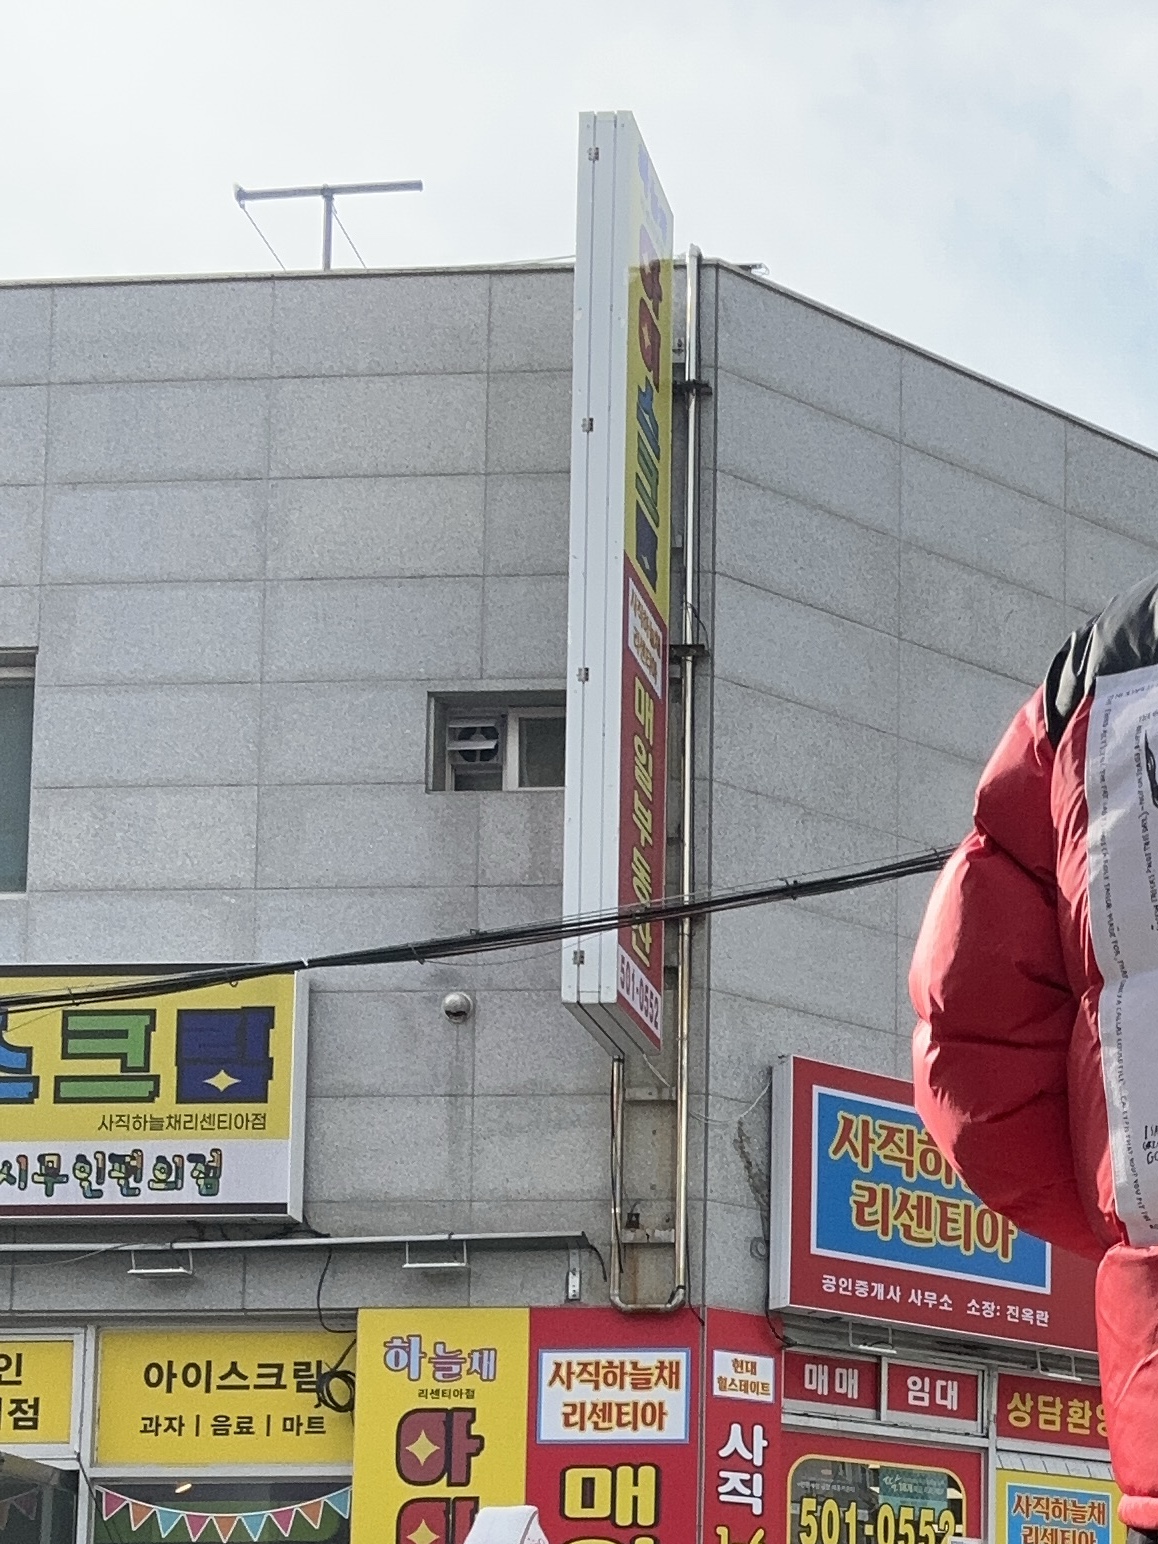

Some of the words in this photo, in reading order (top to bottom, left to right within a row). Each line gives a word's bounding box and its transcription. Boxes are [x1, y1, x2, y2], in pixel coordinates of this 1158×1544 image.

[620, 954, 659, 1030] 501-0552
[97, 1112, 267, 1132] 사직하늘채리센티아점
[850, 1180, 1018, 1262] 리센티아
[821, 1275, 901, 1301] 공인중개사
[908, 1291, 953, 1312] 사무소
[384, 1334, 497, 1382] 하늘채
[732, 1358, 757, 1376] 현대
[143, 1360, 323, 1394] 아이스크림
[549, 1359, 681, 1392] 사직하늘채
[717, 1375, 771, 1396] 힐스테이트
[804, 1363, 859, 1400] 매매
[906, 1374, 959, 1412] 임대
[140, 1415, 185, 1437] 과자
[211, 1415, 256, 1437] 음료
[282, 1416, 327, 1437] 마트
[561, 1400, 668, 1433] 리센티아
[1012, 1493, 1107, 1526] 사직하늘채
